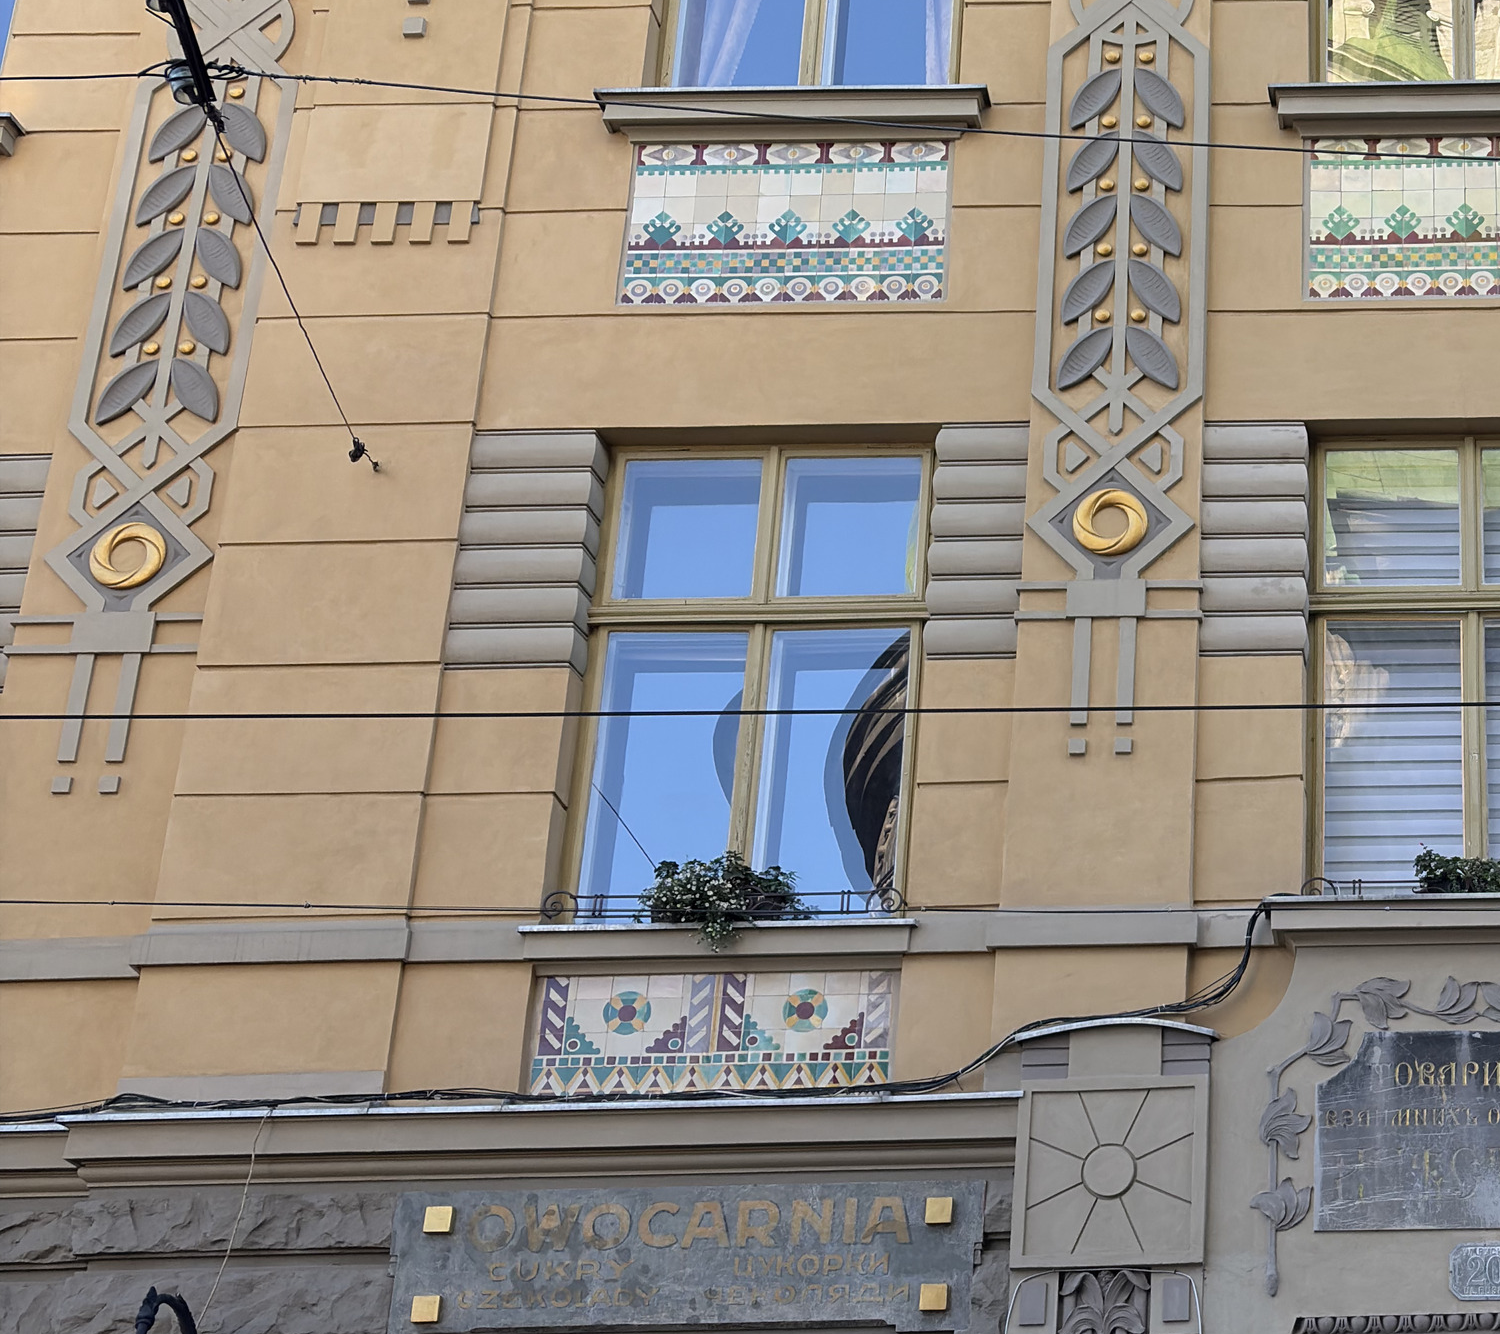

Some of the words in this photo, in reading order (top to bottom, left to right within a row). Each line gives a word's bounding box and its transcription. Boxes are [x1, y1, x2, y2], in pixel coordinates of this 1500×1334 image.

[468, 1196, 912, 1253] OWOCARNIA
[488, 1258, 635, 1282] CUKRY
[733, 1252, 891, 1280] ЦУКОРКИ
